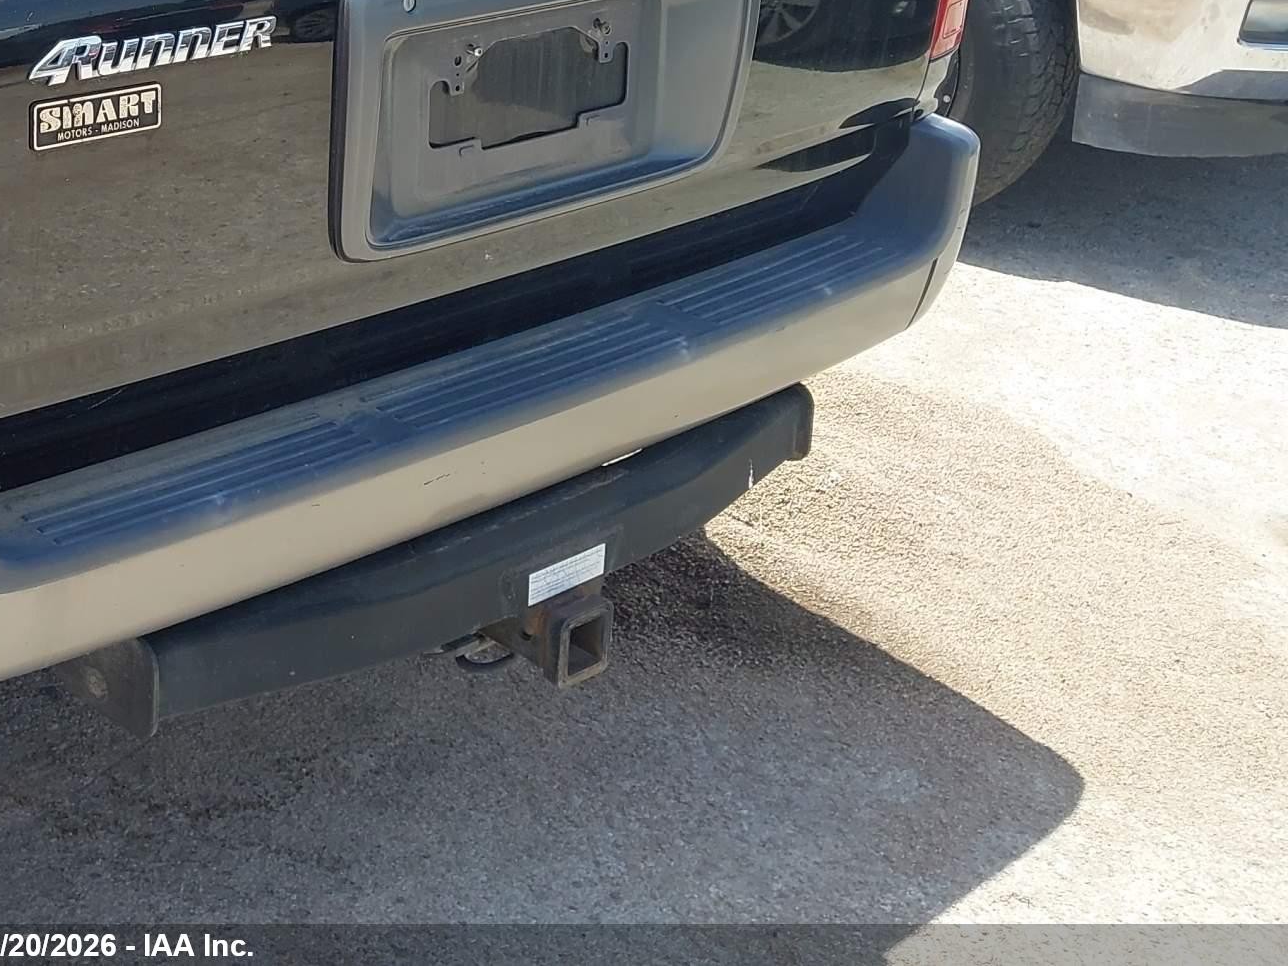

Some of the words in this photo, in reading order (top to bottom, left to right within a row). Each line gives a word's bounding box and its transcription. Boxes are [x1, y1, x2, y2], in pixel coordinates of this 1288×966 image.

[39, 90, 157, 134] SMART
[57, 126, 93, 141] MOTORS
[100, 117, 140, 133] MADISON
